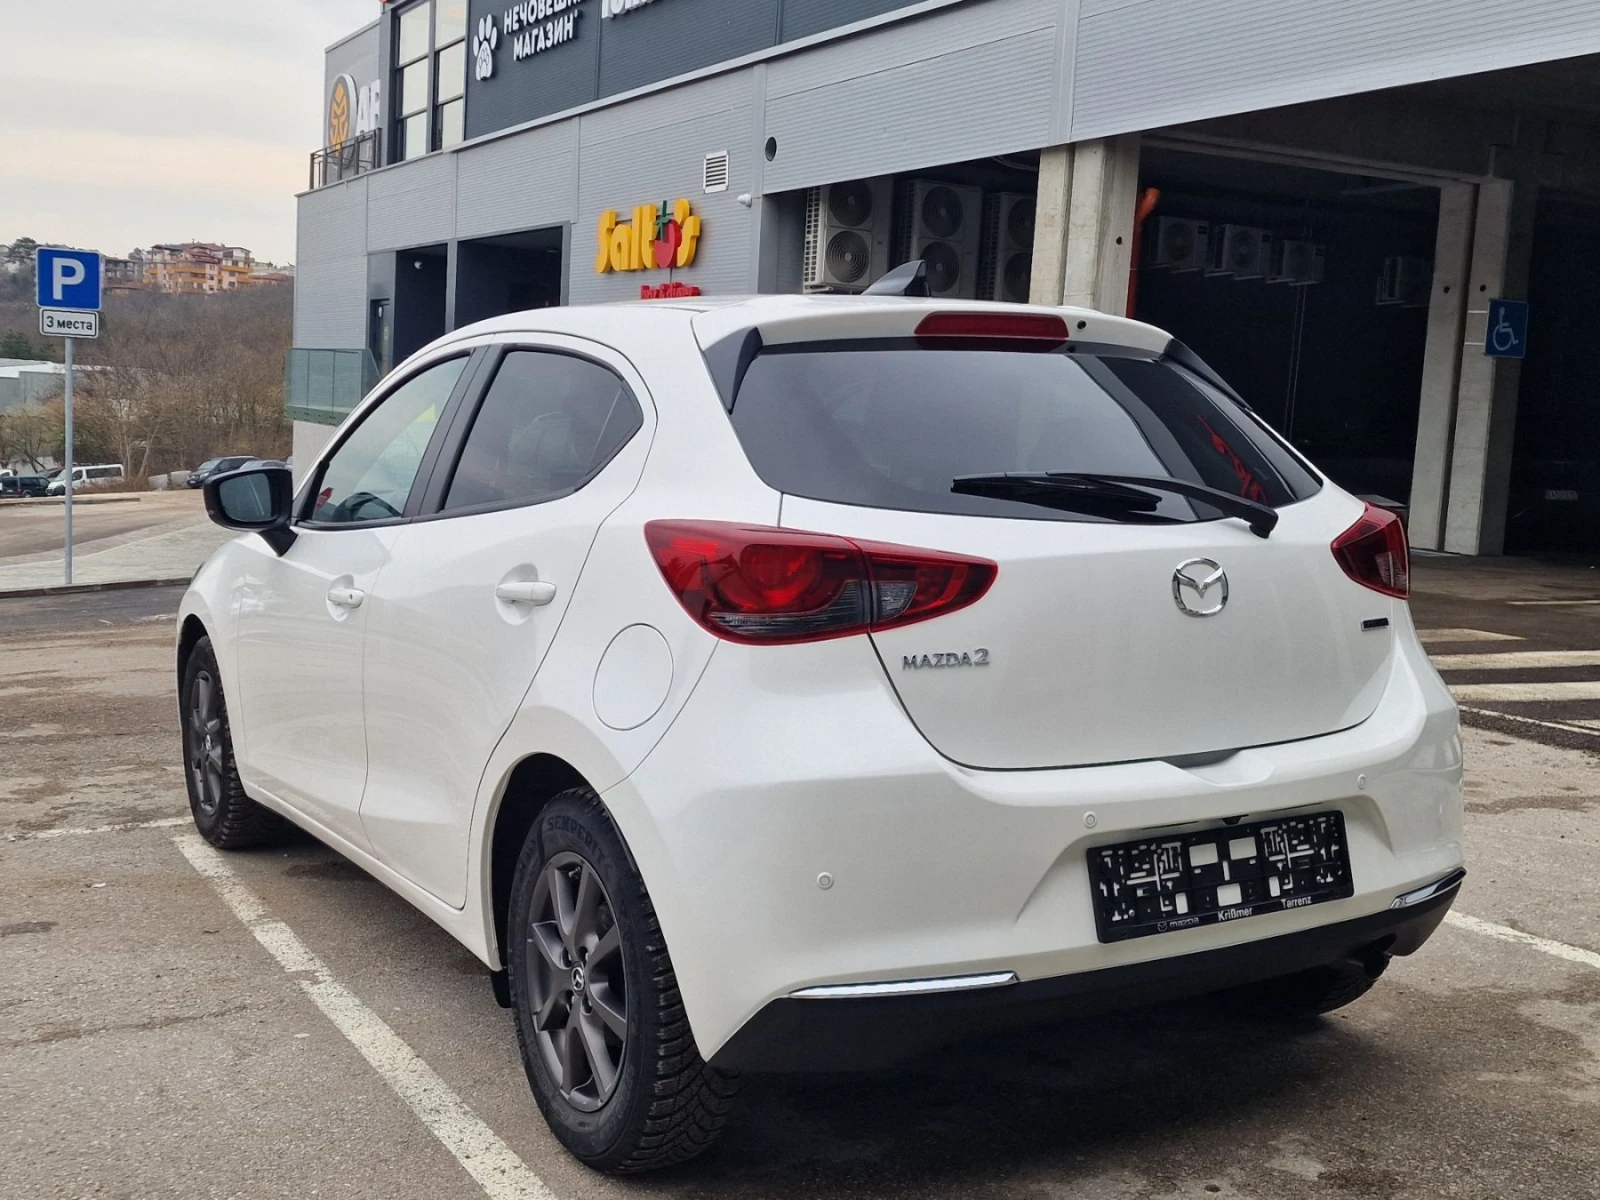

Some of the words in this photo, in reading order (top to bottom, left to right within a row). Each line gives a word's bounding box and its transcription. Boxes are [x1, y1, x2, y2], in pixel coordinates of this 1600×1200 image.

[513, 13, 573, 61] МАГАЗИН
[52, 257, 85, 300] P
[46, 315, 54, 328] 3
[57, 319, 93, 330] места
[1217, 907, 1253, 921] Krißmer
[1280, 896, 1313, 909] Tarrenz
